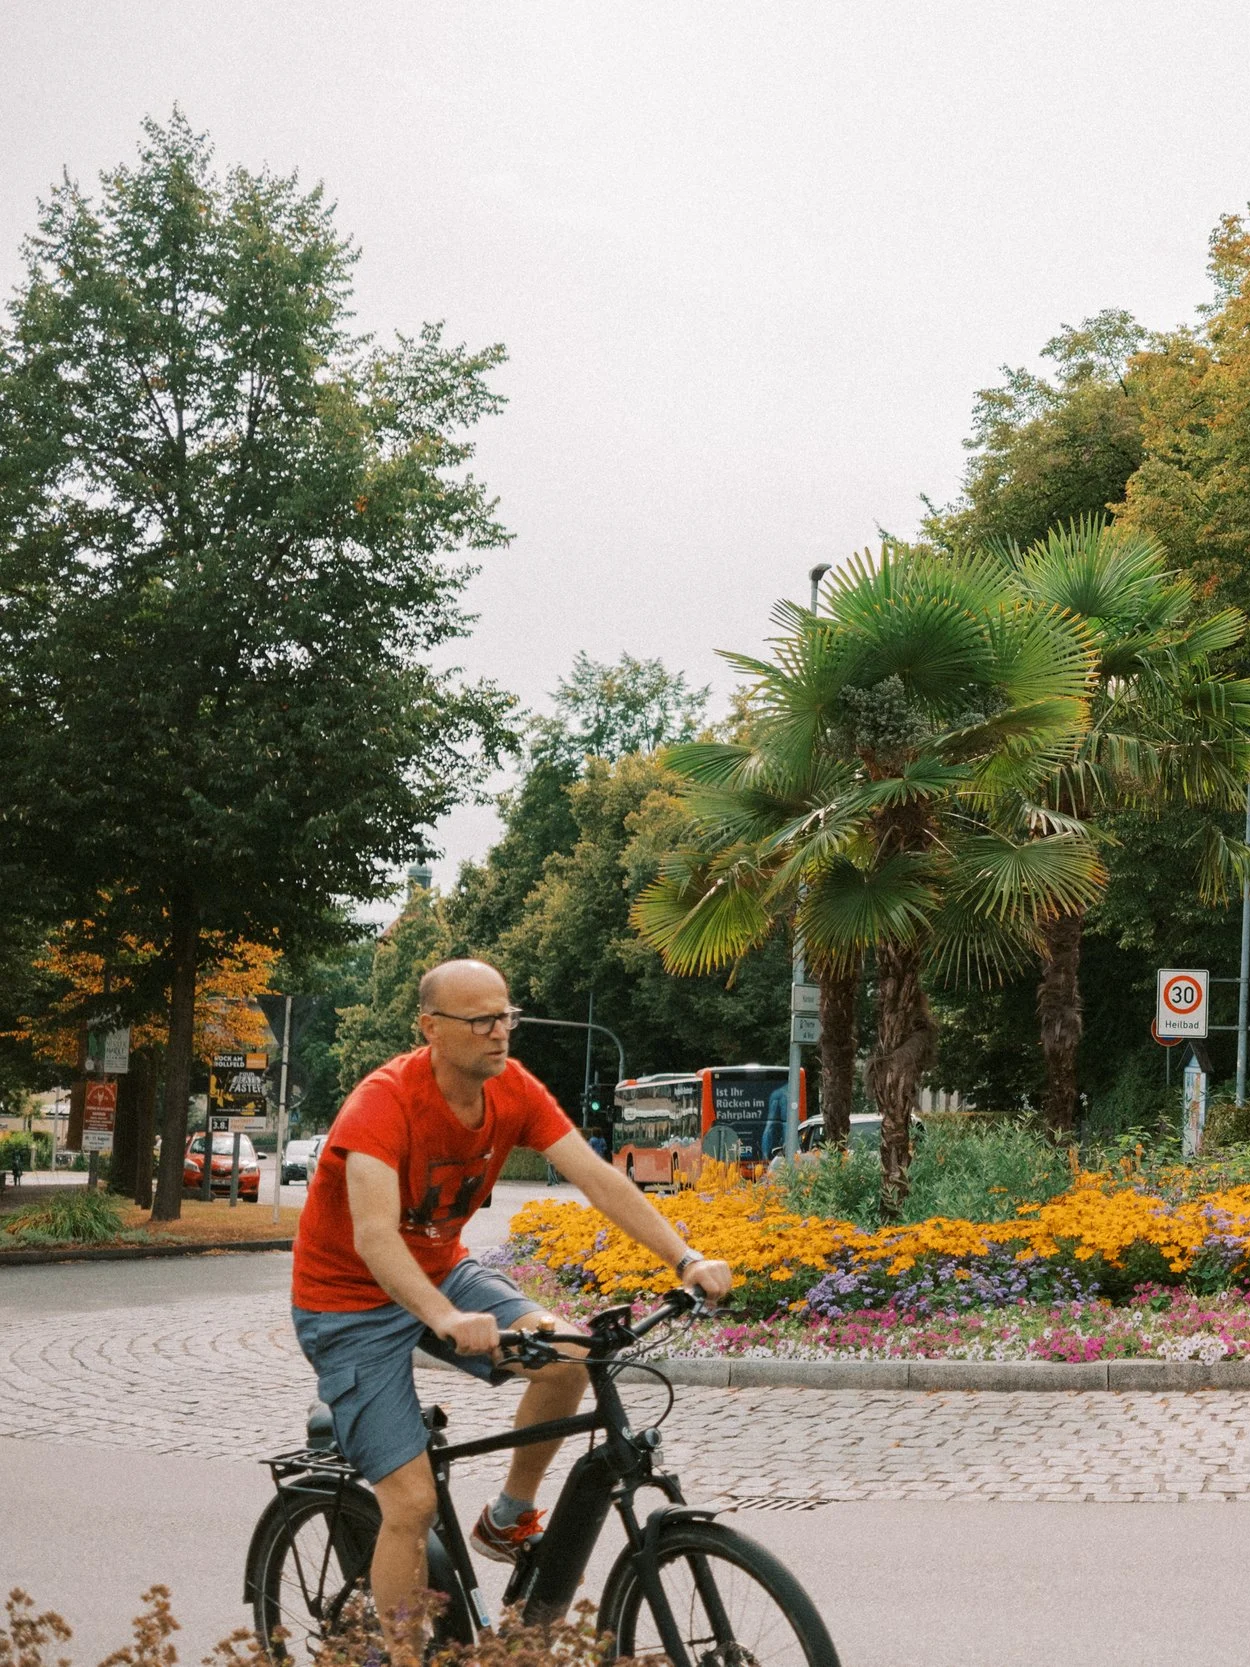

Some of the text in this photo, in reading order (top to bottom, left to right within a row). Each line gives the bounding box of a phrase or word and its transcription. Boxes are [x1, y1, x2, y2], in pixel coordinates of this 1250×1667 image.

[1172, 986, 1194, 1003] 30
[1165, 1021, 1199, 1029] Heilbad
[716, 1087, 744, 1096] Ist Ihr
[716, 1098, 765, 1108] Rücken im
[716, 1110, 762, 1120] Fahrplan?
